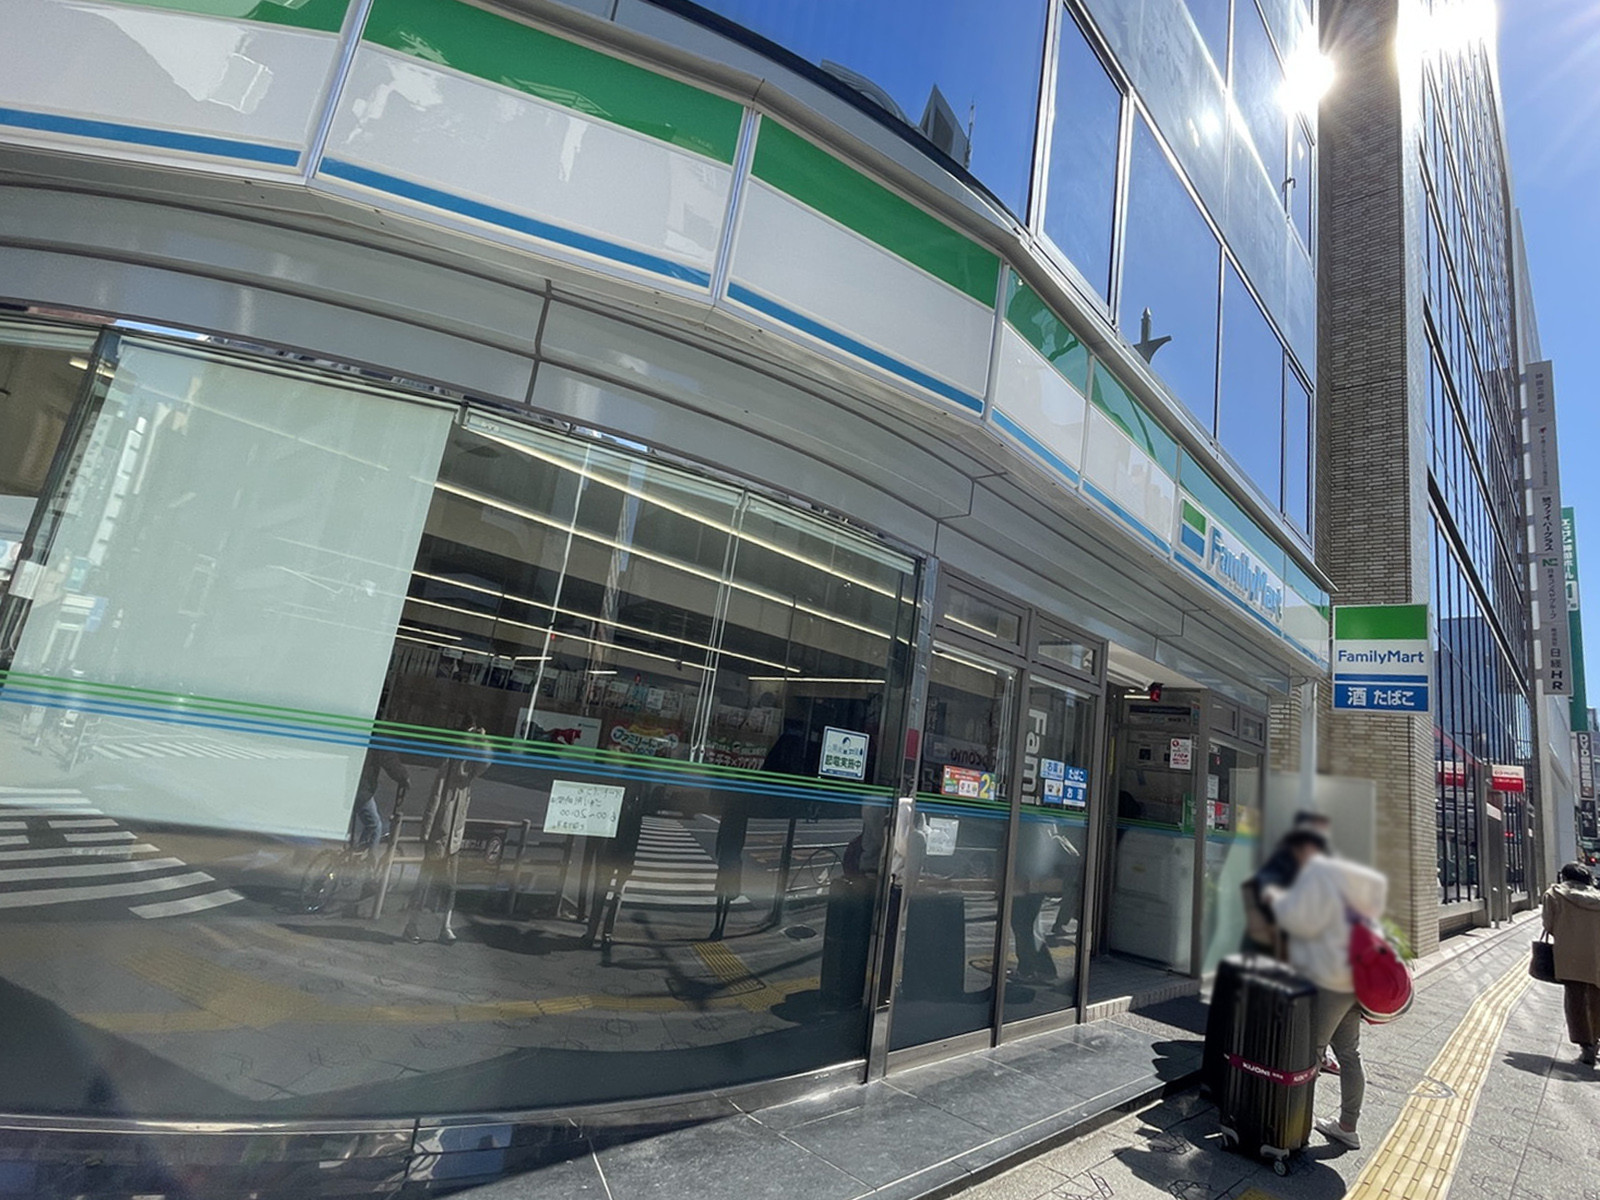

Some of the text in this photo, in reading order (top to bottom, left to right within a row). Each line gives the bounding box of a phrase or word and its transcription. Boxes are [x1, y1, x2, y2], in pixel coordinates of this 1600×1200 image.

[1210, 526, 1282, 620] FamilyMart
[1338, 650, 1425, 664] FamilyMart
[1550, 648, 1563, 690] 日経HR
[1347, 688, 1415, 707] 酒 たばこ
[1578, 734, 1590, 756] DVD
[825, 754, 862, 769] 節電実施中
[1021, 708, 1048, 806] Fami
